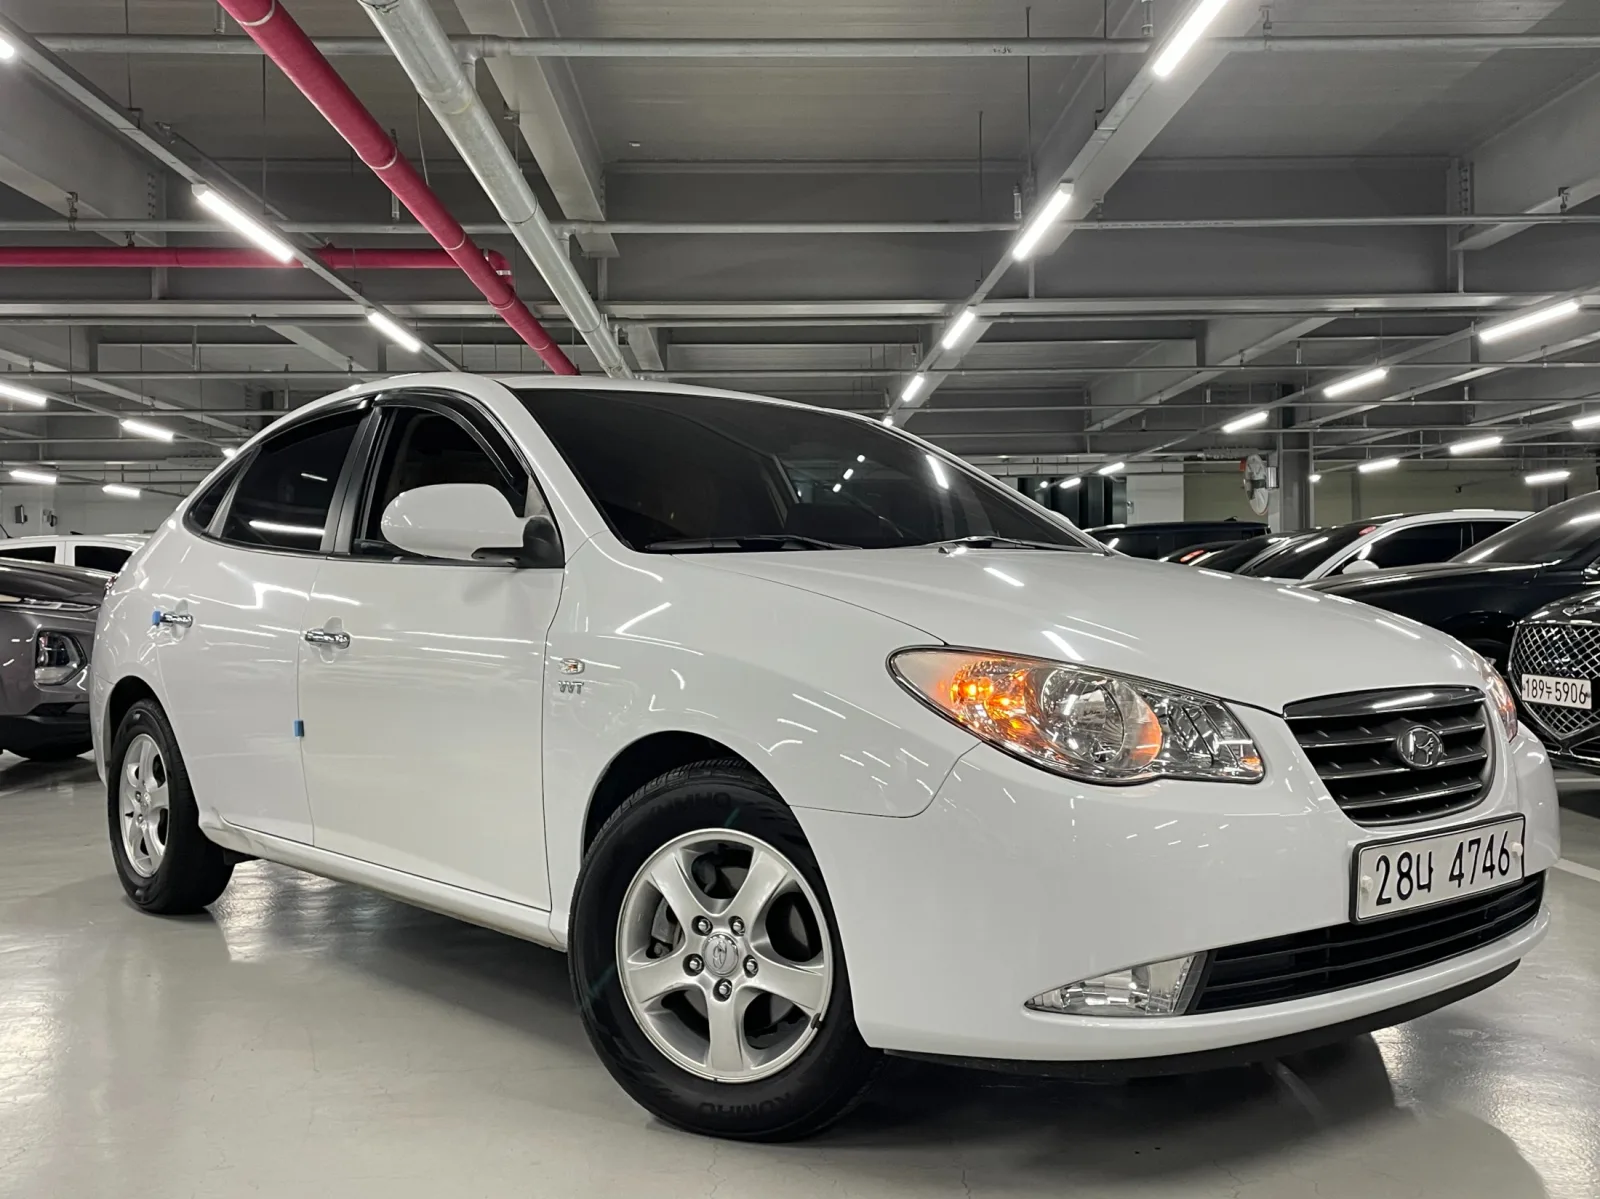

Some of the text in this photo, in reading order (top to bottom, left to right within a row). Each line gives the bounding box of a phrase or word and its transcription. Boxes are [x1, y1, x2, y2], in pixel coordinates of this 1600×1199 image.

[558, 680, 584, 695] VVT
[1526, 678, 1587, 704] 189누 5906
[1376, 831, 1510, 906] 28나 4746
